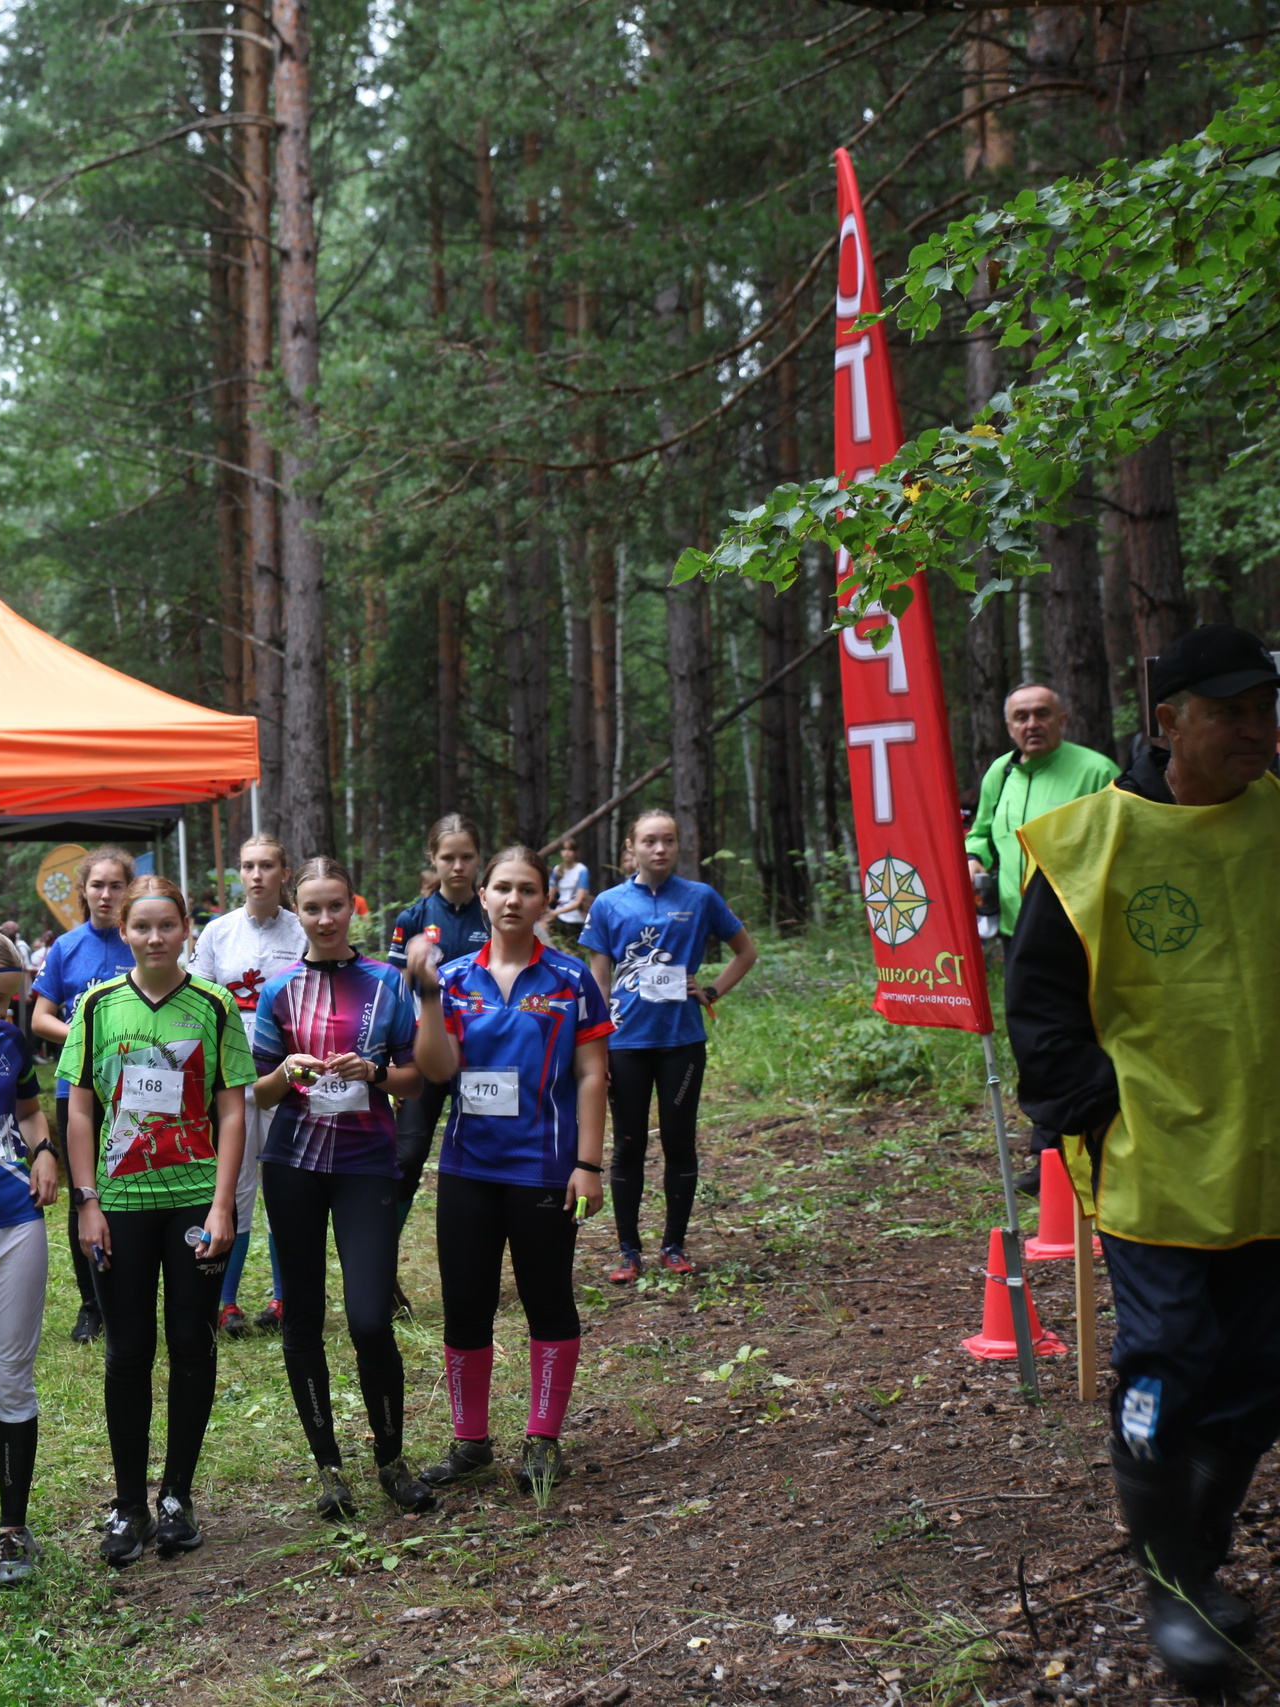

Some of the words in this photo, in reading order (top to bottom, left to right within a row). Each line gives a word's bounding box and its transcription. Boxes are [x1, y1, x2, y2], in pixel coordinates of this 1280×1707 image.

[651, 975, 670, 985] 180
[118, 1042, 130, 1056] N
[137, 1078, 162, 1093] 168
[322, 1080, 348, 1094] 169
[474, 1083, 499, 1096] 170
[105, 1139, 114, 1152] S
[451, 1366, 464, 1424] NORDSKI
[537, 1359, 554, 1419] NORDSKI
